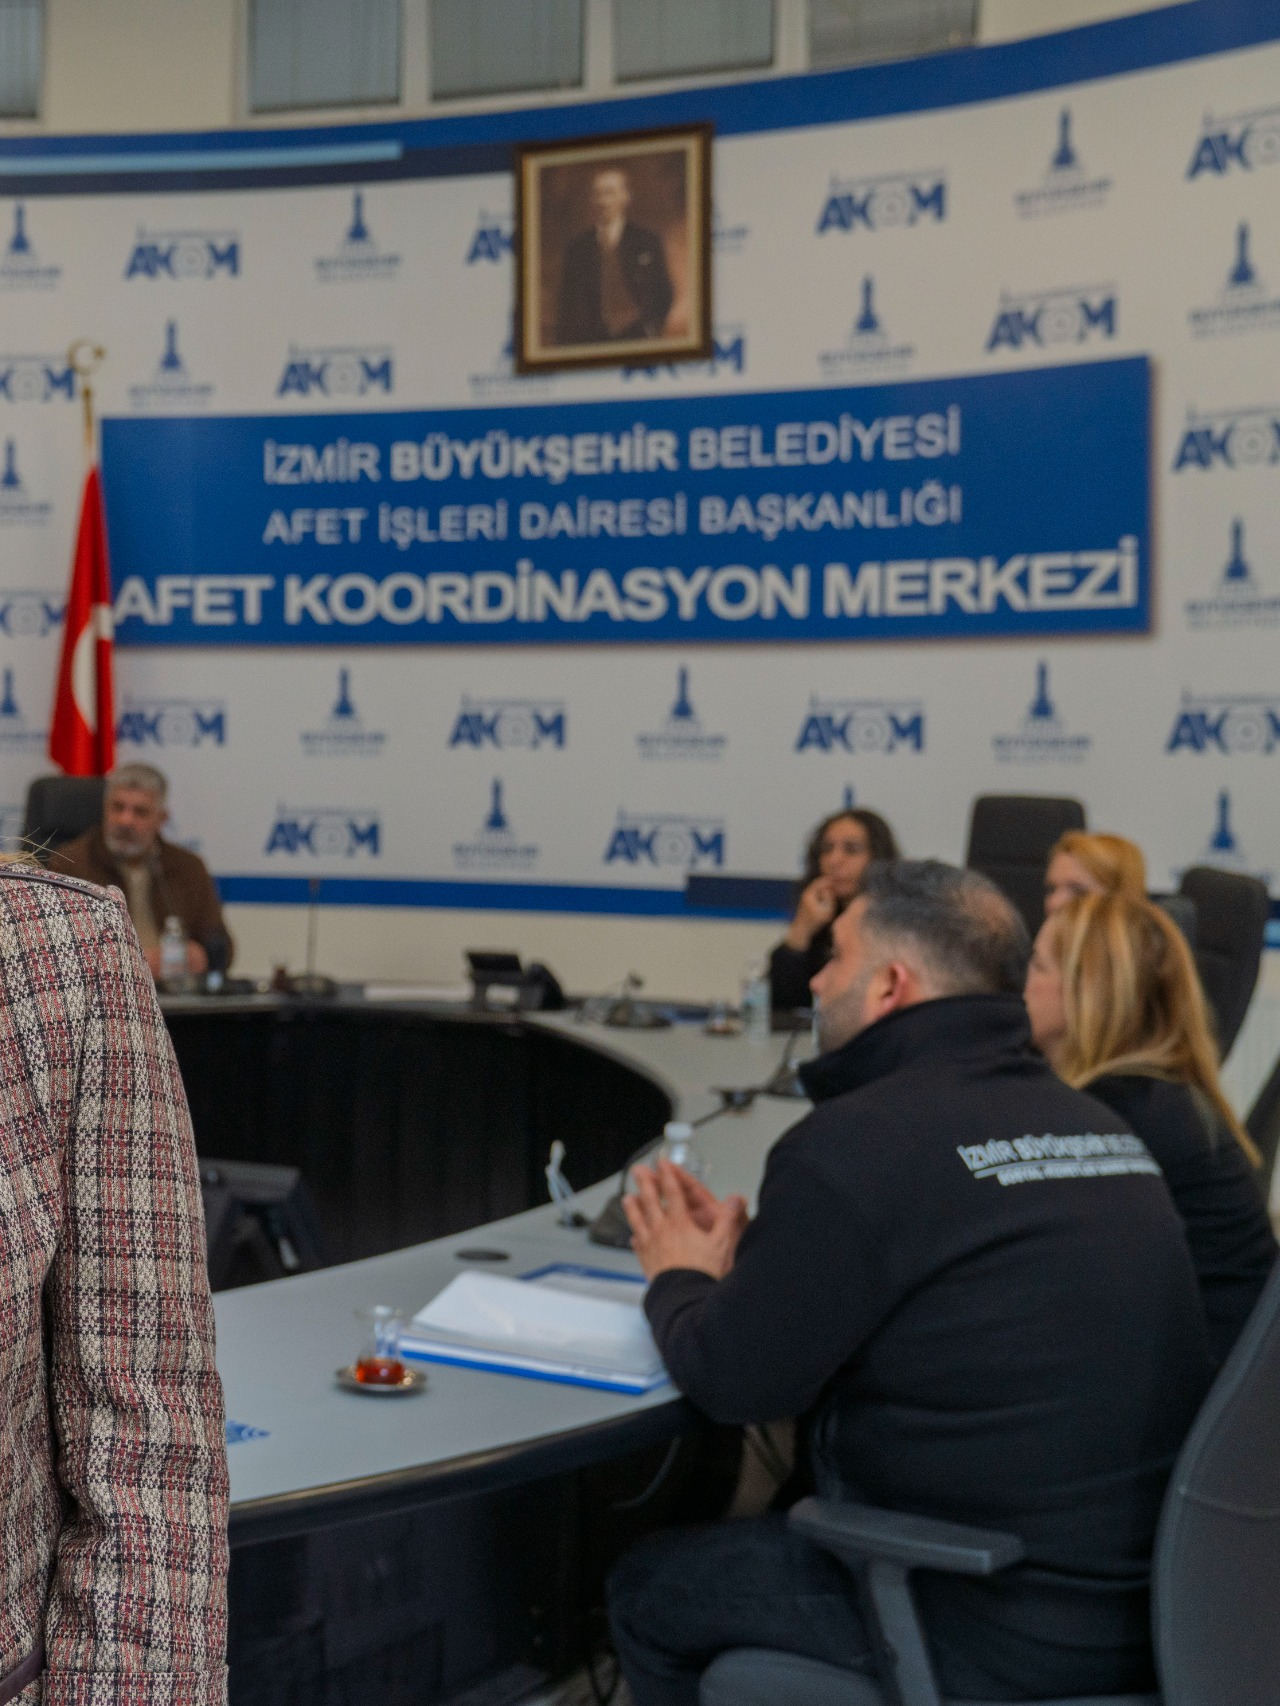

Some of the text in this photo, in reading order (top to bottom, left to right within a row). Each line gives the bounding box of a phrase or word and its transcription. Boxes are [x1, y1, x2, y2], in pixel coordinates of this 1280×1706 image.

[263, 403, 962, 485] İZMİR BÜYÜKŞEHİR BELEDİYESİ
[262, 480, 962, 551] AFET İŞLERİ DAİRESİ BAŞKANLIĞI
[113, 574, 275, 627] AFET
[283, 557, 810, 626] KOORDİNASYON
[822, 534, 1139, 620] MERKEZİ
